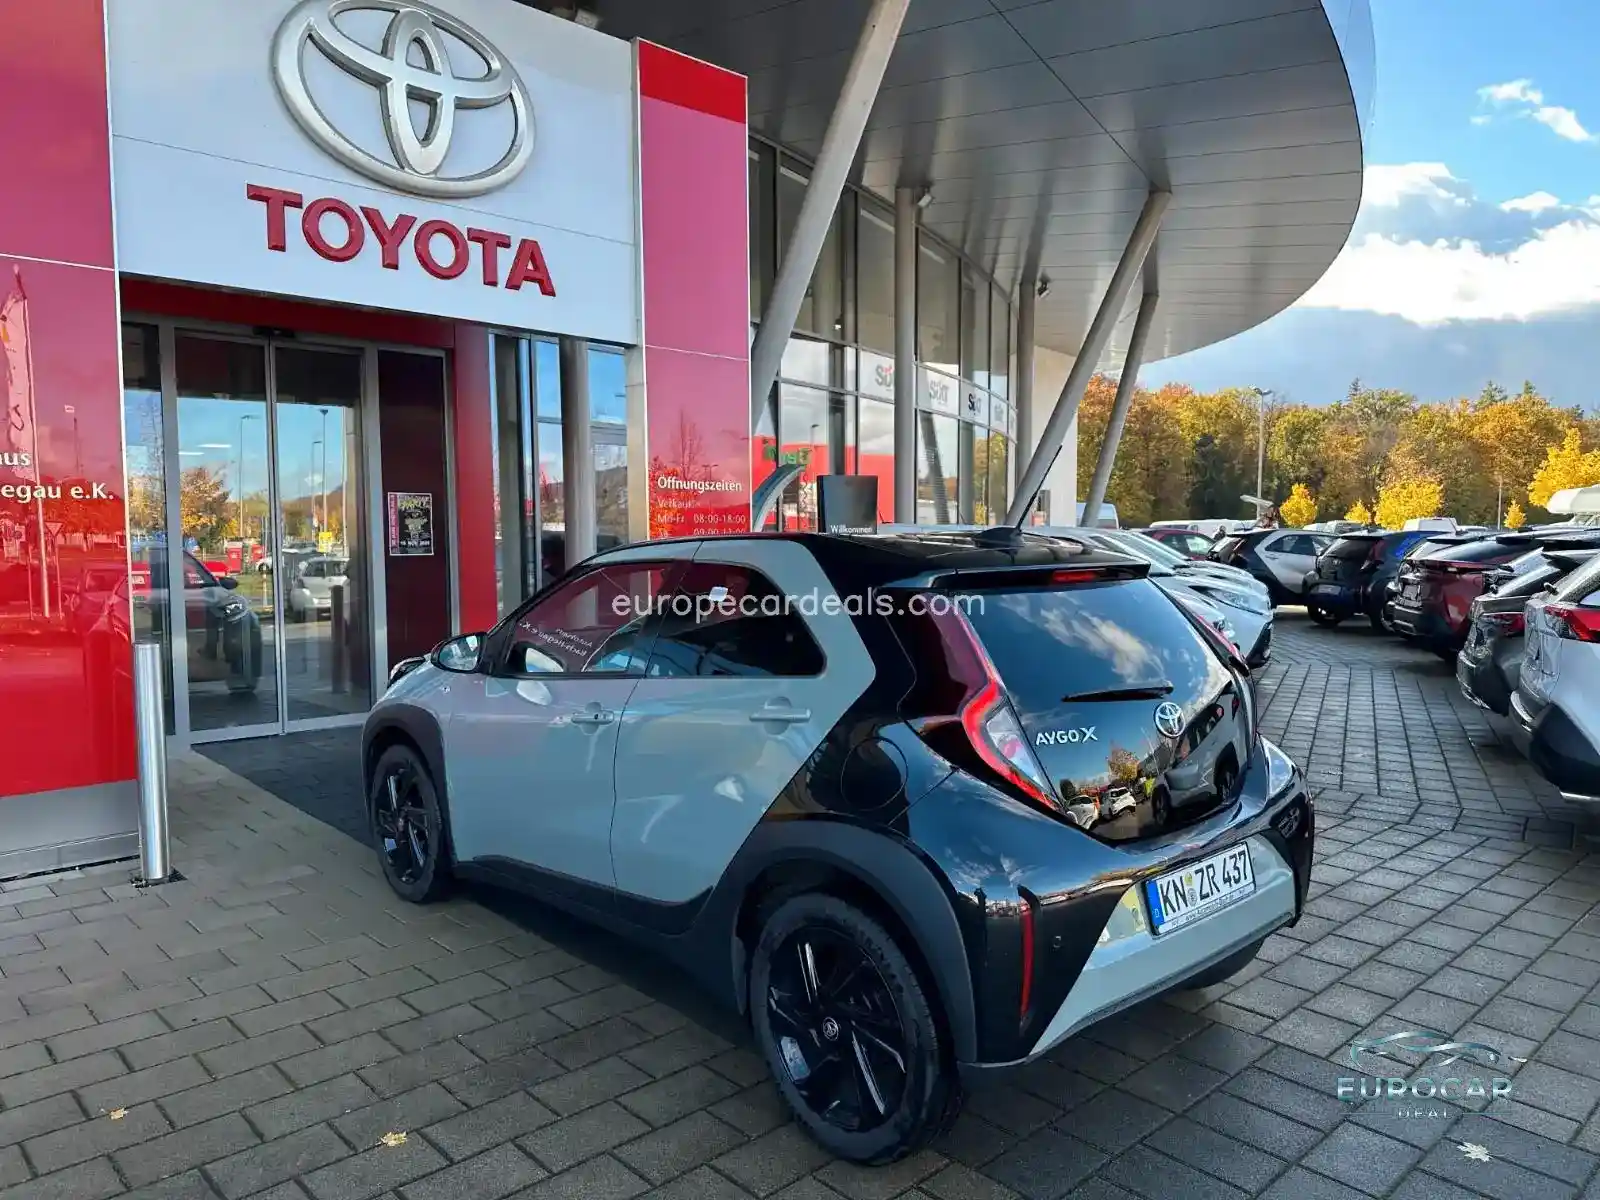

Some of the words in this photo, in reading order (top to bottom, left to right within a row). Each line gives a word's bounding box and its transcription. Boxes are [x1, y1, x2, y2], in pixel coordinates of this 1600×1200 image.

[246, 183, 556, 298] TOYOTA
[0, 452, 31, 466] us
[70, 482, 114, 499] e.K.
[657, 474, 742, 493] Öffnungszeiten
[830, 524, 873, 534] Willkommen
[1035, 730, 1079, 746] AYGO
[1079, 726, 1098, 744] X
[1160, 875, 1188, 917] KN
[1194, 863, 1221, 901] ZR
[1222, 850, 1248, 887] 437
